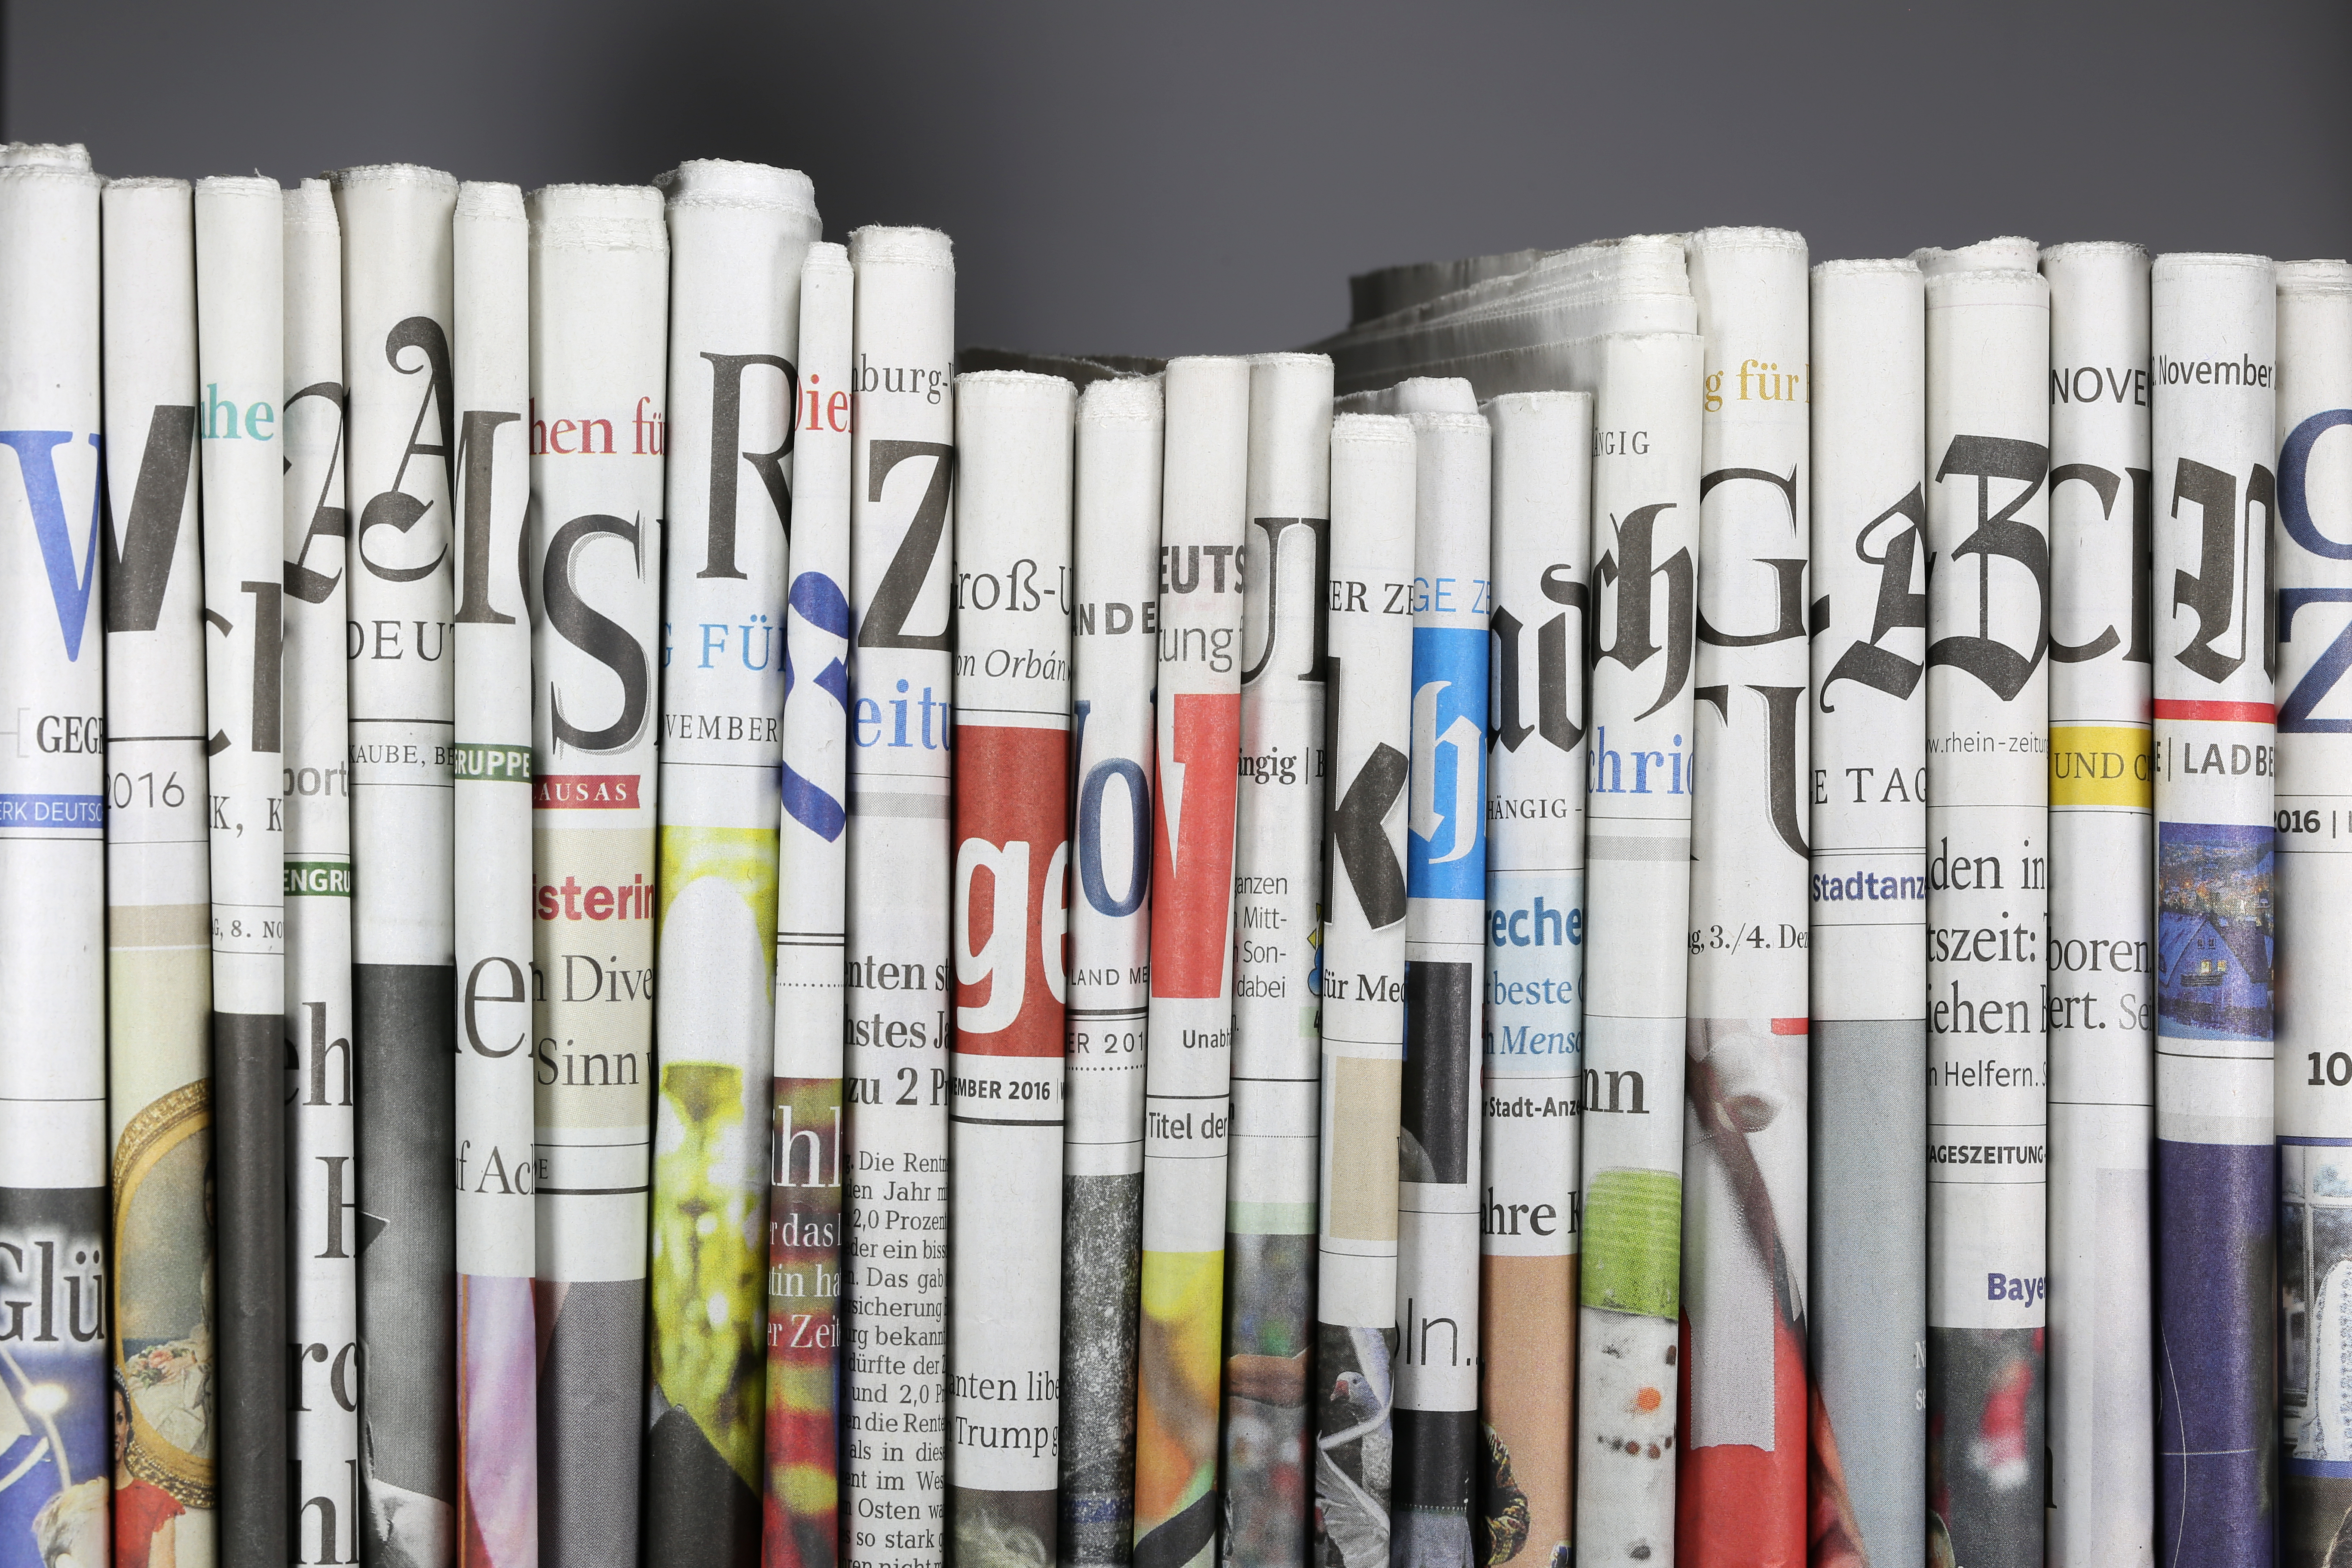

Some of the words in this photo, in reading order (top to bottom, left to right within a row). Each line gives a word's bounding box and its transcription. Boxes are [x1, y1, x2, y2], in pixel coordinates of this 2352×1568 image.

[852, 352, 954, 404] burg-
[1736, 359, 1799, 401] für
[2159, 353, 2273, 388] November
[2050, 367, 2150, 407] NOVE
[202, 383, 275, 441] he
[795, 374, 852, 434] ie
[631, 396, 668, 456] fü
[858, 439, 953, 652] Z
[953, 559, 1072, 616] roß-U
[1329, 580, 1369, 612] ER
[1075, 602, 1155, 636] NDE
[542, 510, 652, 761] S
[698, 614, 787, 672] FÜ
[955, 655, 975, 677] on
[985, 649, 1066, 681] Orbán
[660, 714, 778, 743] VEMBER
[349, 744, 426, 767] AUBE,
[1238, 747, 1297, 785] ngig
[2054, 753, 2124, 778] UND
[533, 782, 628, 802] AUSAS
[35, 802, 103, 822] DEUTSC
[210, 795, 243, 838] K,
[266, 797, 283, 832] K
[1926, 836, 2003, 890] den
[1234, 876, 1288, 895] anzen
[1813, 871, 1926, 902] Stadtanz
[230, 920, 252, 938] 8.
[262, 921, 284, 939] NO
[1244, 906, 1286, 930] Mitt-
[1243, 940, 1286, 964] Son-
[1688, 930, 1705, 955] g,
[561, 955, 653, 1002] Dive
[1067, 968, 1120, 986] LAND
[1237, 974, 1285, 998] dabei
[1494, 970, 1572, 1005] beste
[2048, 991, 2106, 1030] ert.
[2119, 994, 2154, 1031] Sei
[1183, 1028, 1231, 1048] Unabh
[1501, 1026, 1581, 1055] Mensc
[538, 1037, 639, 1086] Sinn
[848, 1077, 883, 1105] zu
[896, 1067, 918, 1106] 2
[930, 1068, 950, 1106] Pr
[949, 1079, 1001, 1099] EMBER
[1009, 1081, 1050, 1100] 2016
[1489, 1096, 1581, 1118] Stadt-Anze
[1149, 1112, 1192, 1140] Titel
[859, 1151, 894, 1172] Die
[903, 1152, 949, 1174] Rentn
[1927, 1145, 2043, 1164] AGESZEITUNG
[474, 1145, 535, 1195] Ac
[884, 1181, 931, 1201] Jahr
[782, 1213, 834, 1247] das
[853, 1208, 879, 1232] 2,0
[842, 1237, 878, 1259] eder
[883, 1240, 918, 1259] ein
[923, 1240, 946, 1259] biss
[769, 1264, 805, 1297] tin
[814, 1264, 840, 1298] ha
[867, 1267, 908, 1288] Das
[917, 1268, 943, 1294] gab
[1988, 1273, 2046, 1307] Baye
[790, 1314, 840, 1349] Zeit
[848, 1353, 906, 1375] dürfte
[914, 1355, 940, 1375] der
[852, 1384, 887, 1403] und
[900, 1384, 929, 1407] 2,0
[949, 1372, 1018, 1401] anten
[865, 1412, 897, 1433] die
[903, 1413, 945, 1433] Rente
[956, 1416, 1048, 1458] Trump
[849, 1439, 872, 1460] als
[883, 1442, 904, 1462] in
[876, 1470, 905, 1490] im
[916, 1471, 944, 1491] Wes
[858, 1498, 920, 1520] Osten
[857, 1531, 875, 1547] so
[885, 1529, 934, 1549] stark
